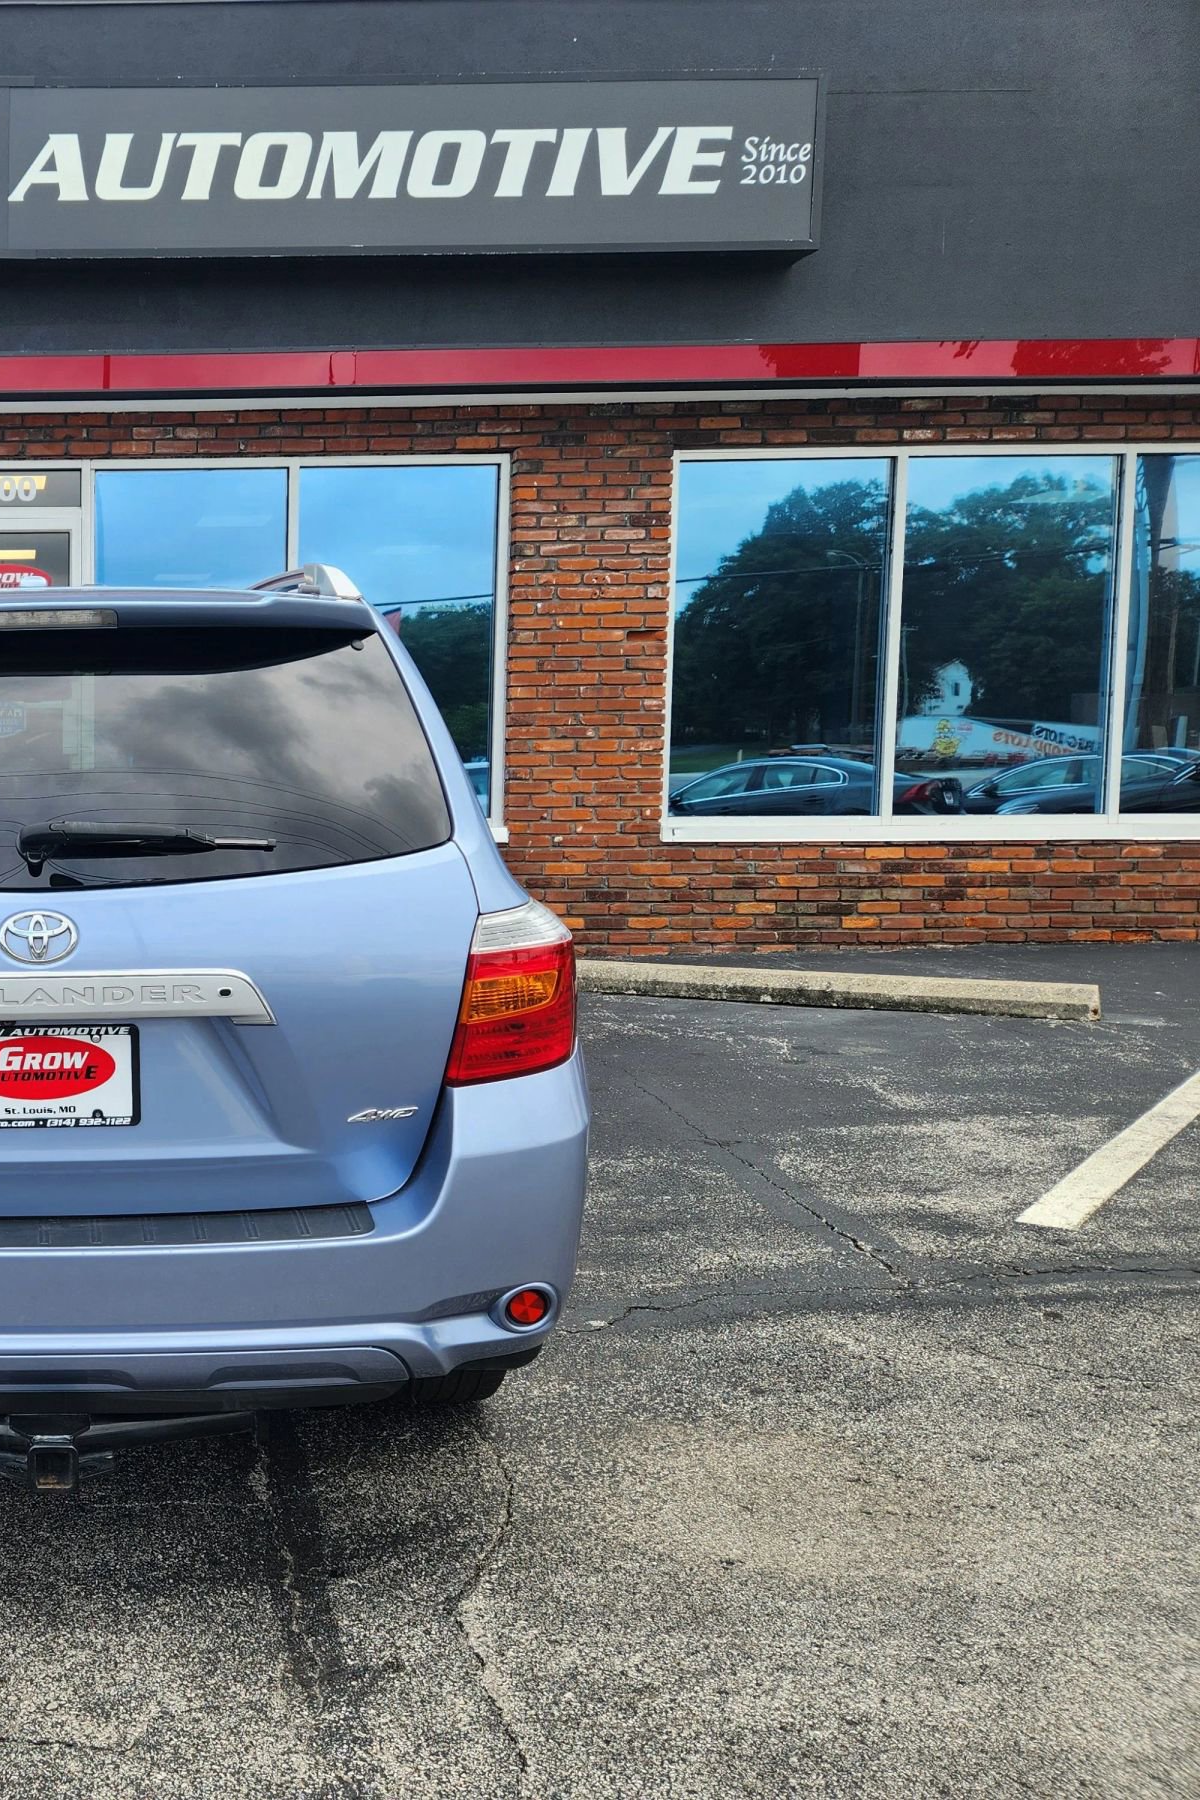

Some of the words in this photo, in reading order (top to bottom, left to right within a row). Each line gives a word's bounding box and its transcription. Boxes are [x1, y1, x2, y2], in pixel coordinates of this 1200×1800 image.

[741, 136, 811, 162] Since
[7, 126, 733, 202] AUTOMOTIVE
[740, 164, 806, 184] 2010
[10, 1026, 130, 1036] AUTOMOTIVE
[4, 1106, 20, 1115] St.
[23, 1106, 56, 1115] Louis,
[58, 1105, 76, 1113] MO
[347, 1106, 419, 1122] 4WD
[46, 1118, 75, 1127] (314)
[78, 1117, 131, 1126] 932-1122
